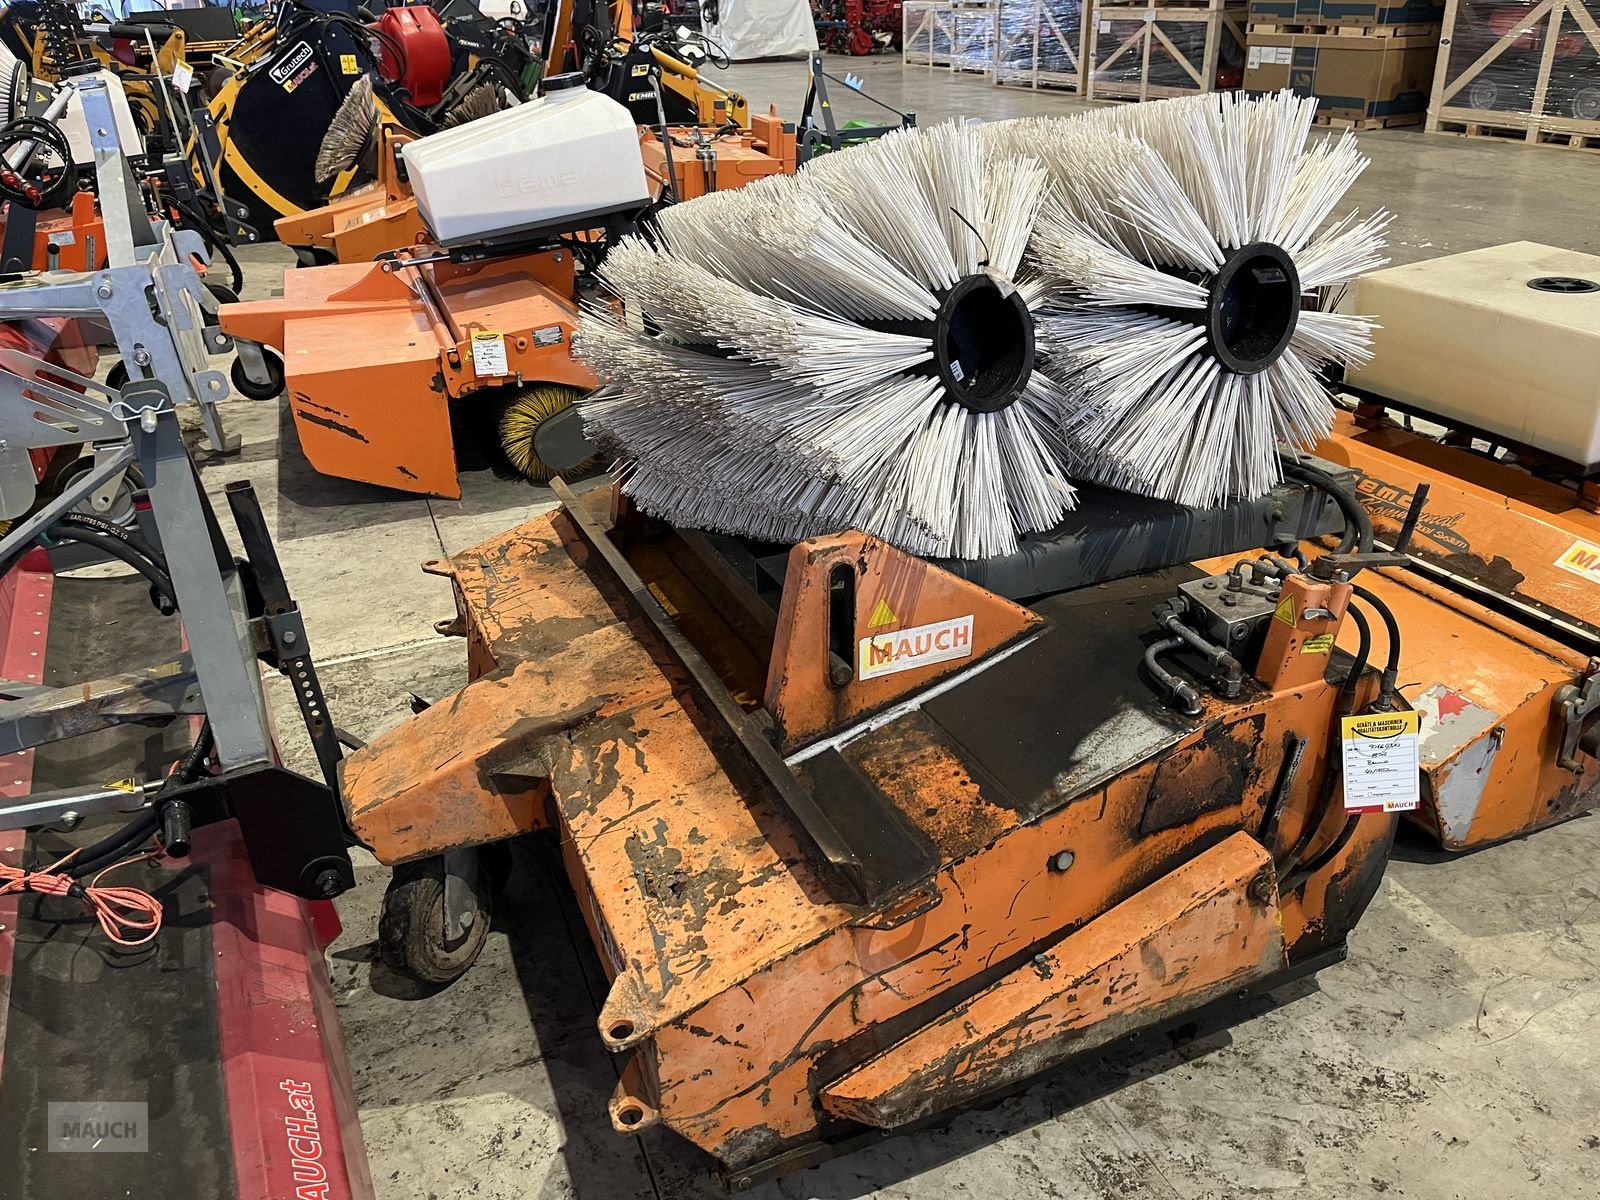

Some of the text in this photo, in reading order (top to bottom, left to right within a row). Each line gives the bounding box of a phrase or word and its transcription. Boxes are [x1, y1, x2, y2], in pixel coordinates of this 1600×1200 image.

[280, 47, 310, 76] Grutech
[496, 170, 581, 199] bema
[1433, 530, 1468, 549] System
[869, 625, 969, 667] MAUCH
[1387, 801, 1414, 809] MAUCH
